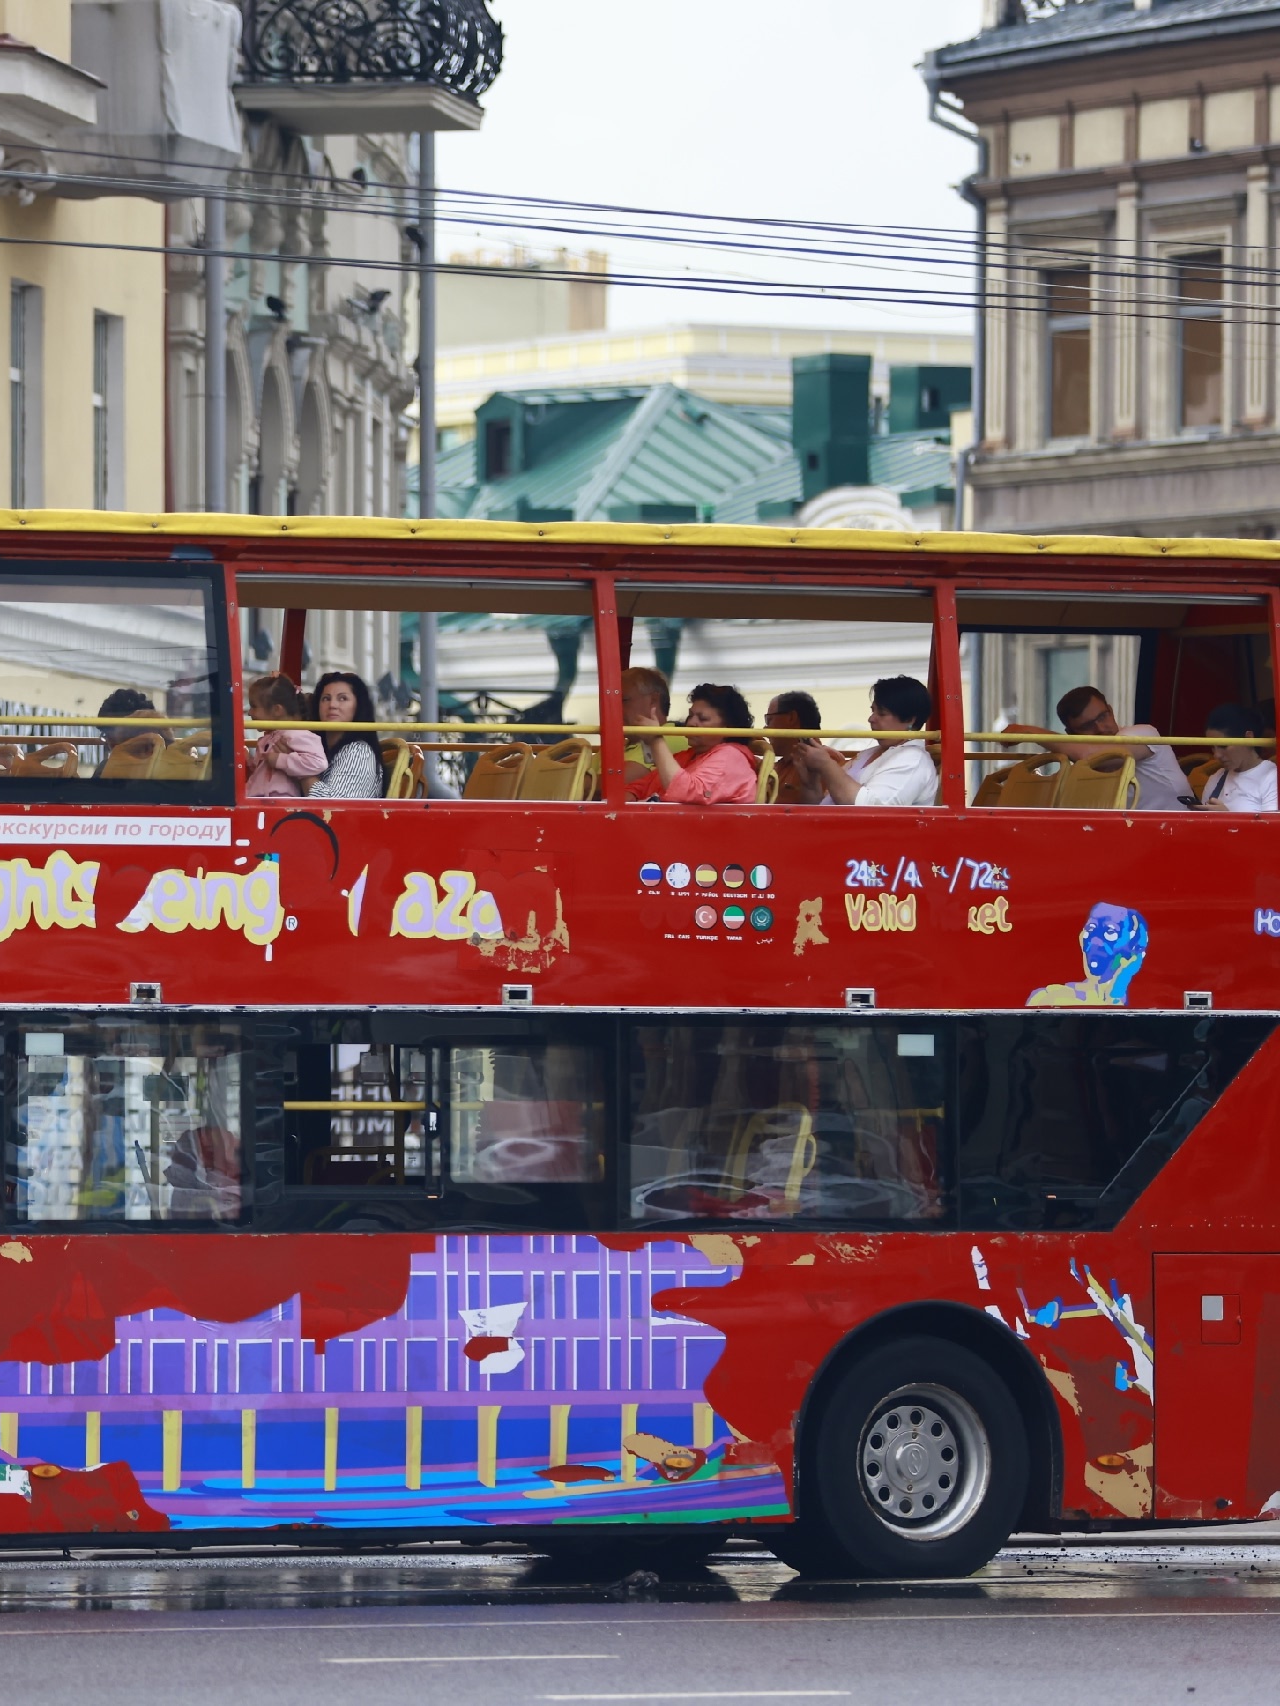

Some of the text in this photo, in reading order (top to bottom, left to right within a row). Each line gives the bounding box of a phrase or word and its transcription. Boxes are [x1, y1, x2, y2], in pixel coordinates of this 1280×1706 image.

[114, 822, 142, 836] по
[148, 823, 227, 842] городу
[844, 893, 917, 932] Valid
